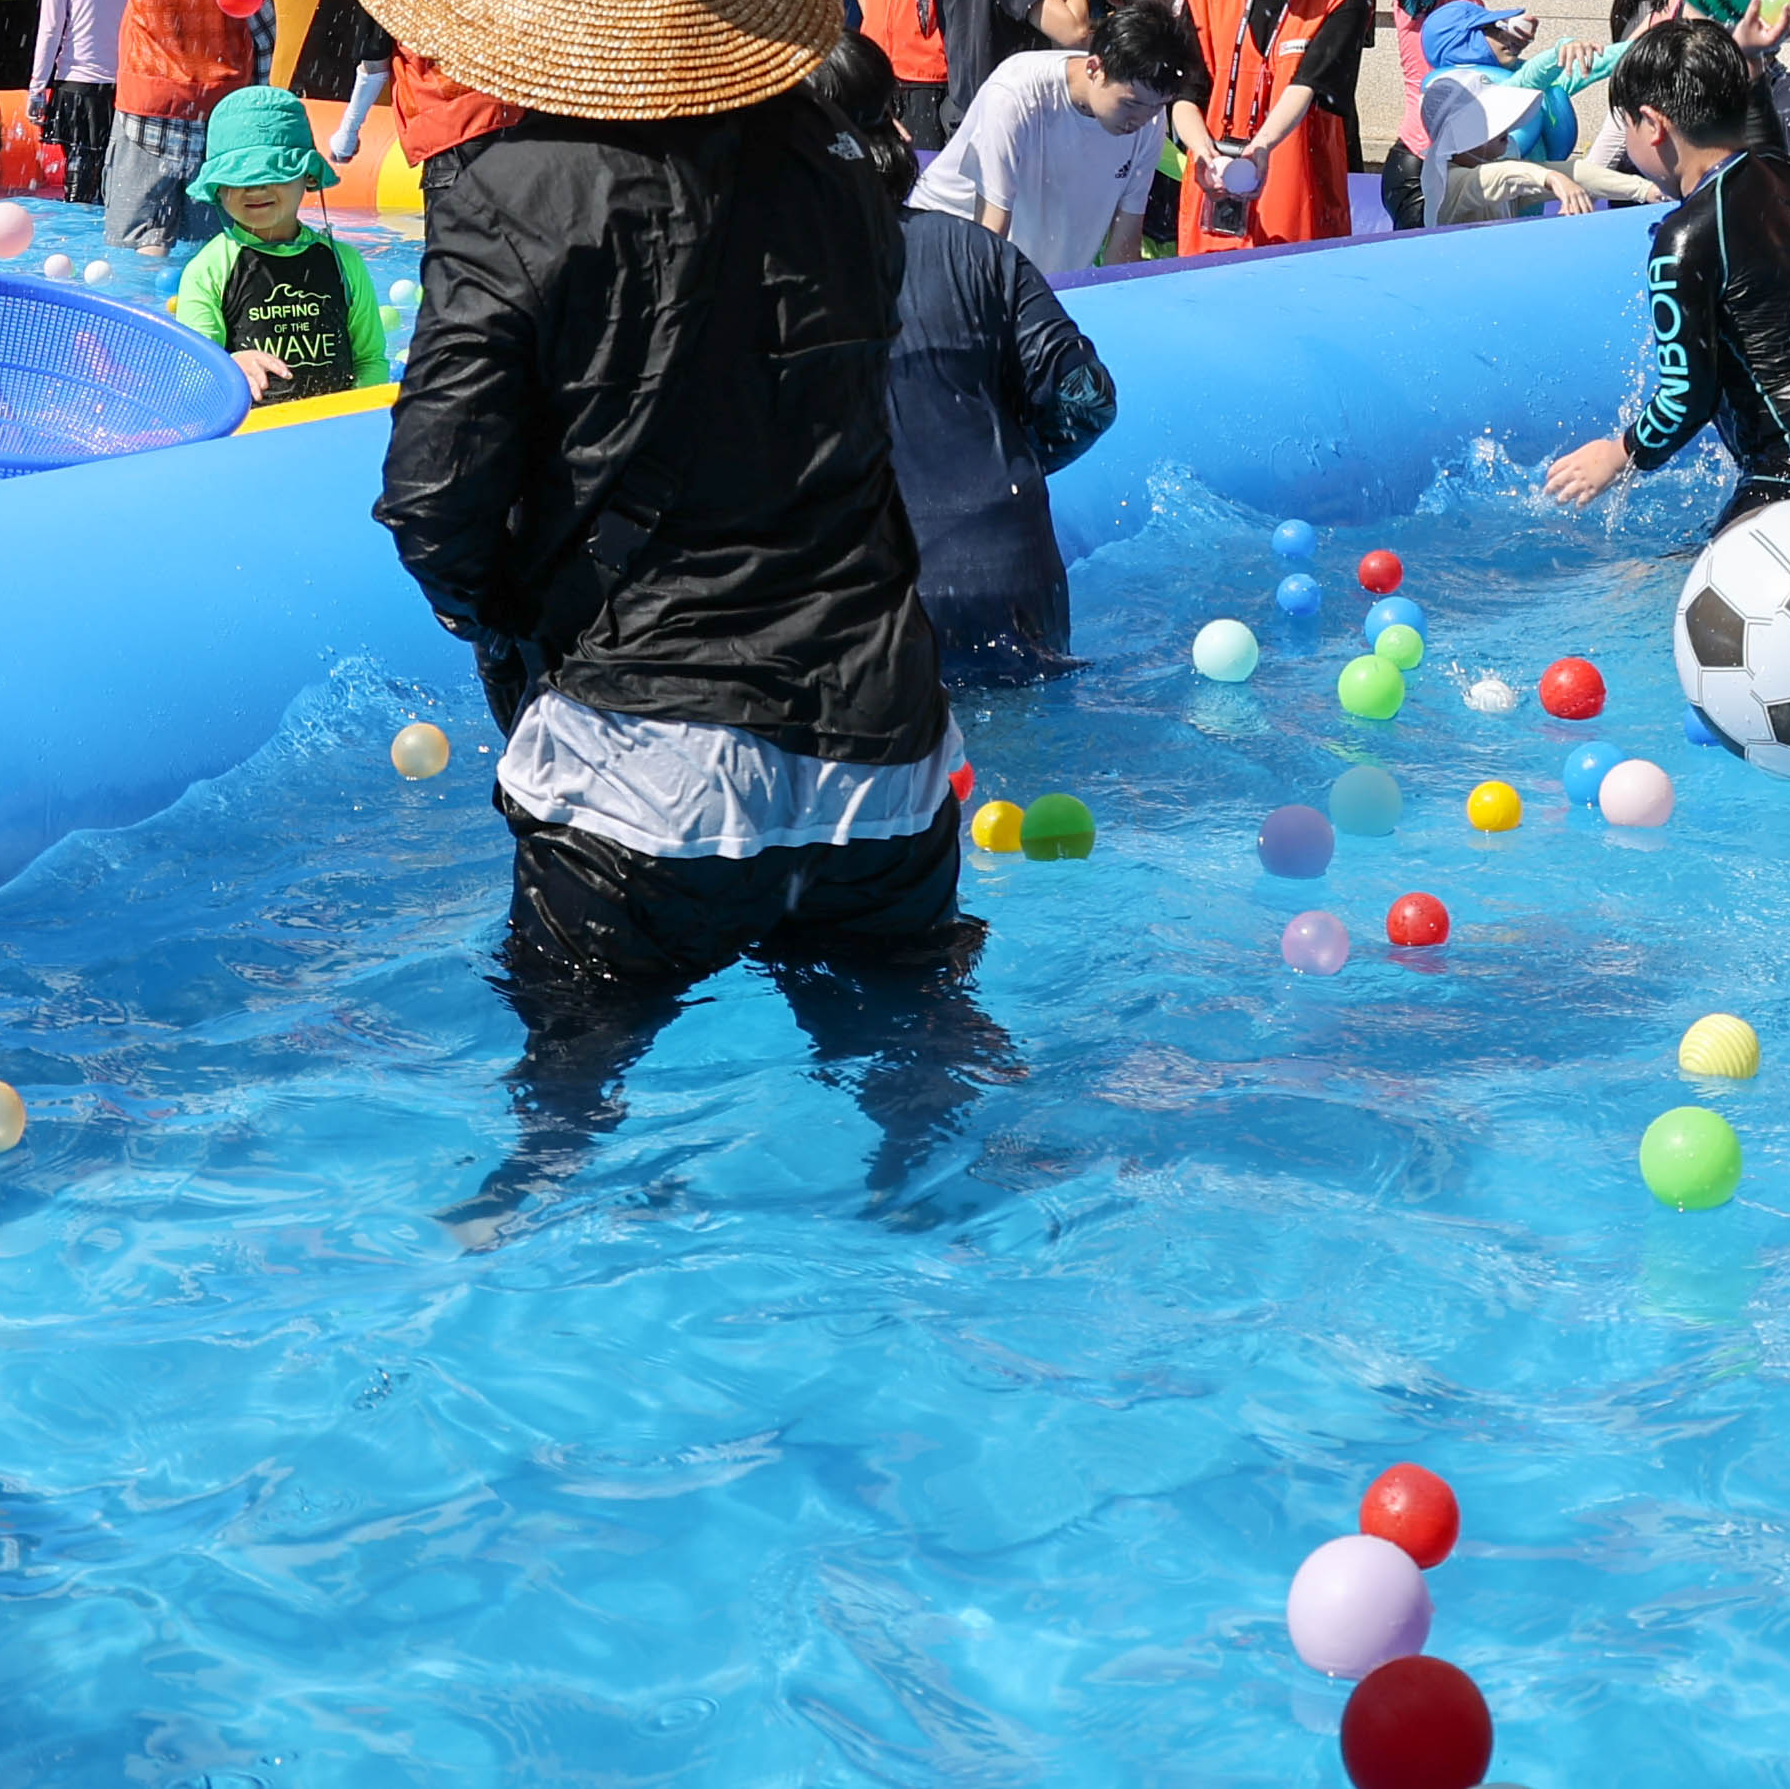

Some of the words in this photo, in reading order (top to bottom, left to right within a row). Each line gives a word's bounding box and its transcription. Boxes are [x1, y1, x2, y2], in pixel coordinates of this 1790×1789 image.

[248, 303, 320, 321] SURFING
[274, 324, 288, 333] OF
[290, 322, 310, 332] THE
[253, 334, 336, 361] WAVE
